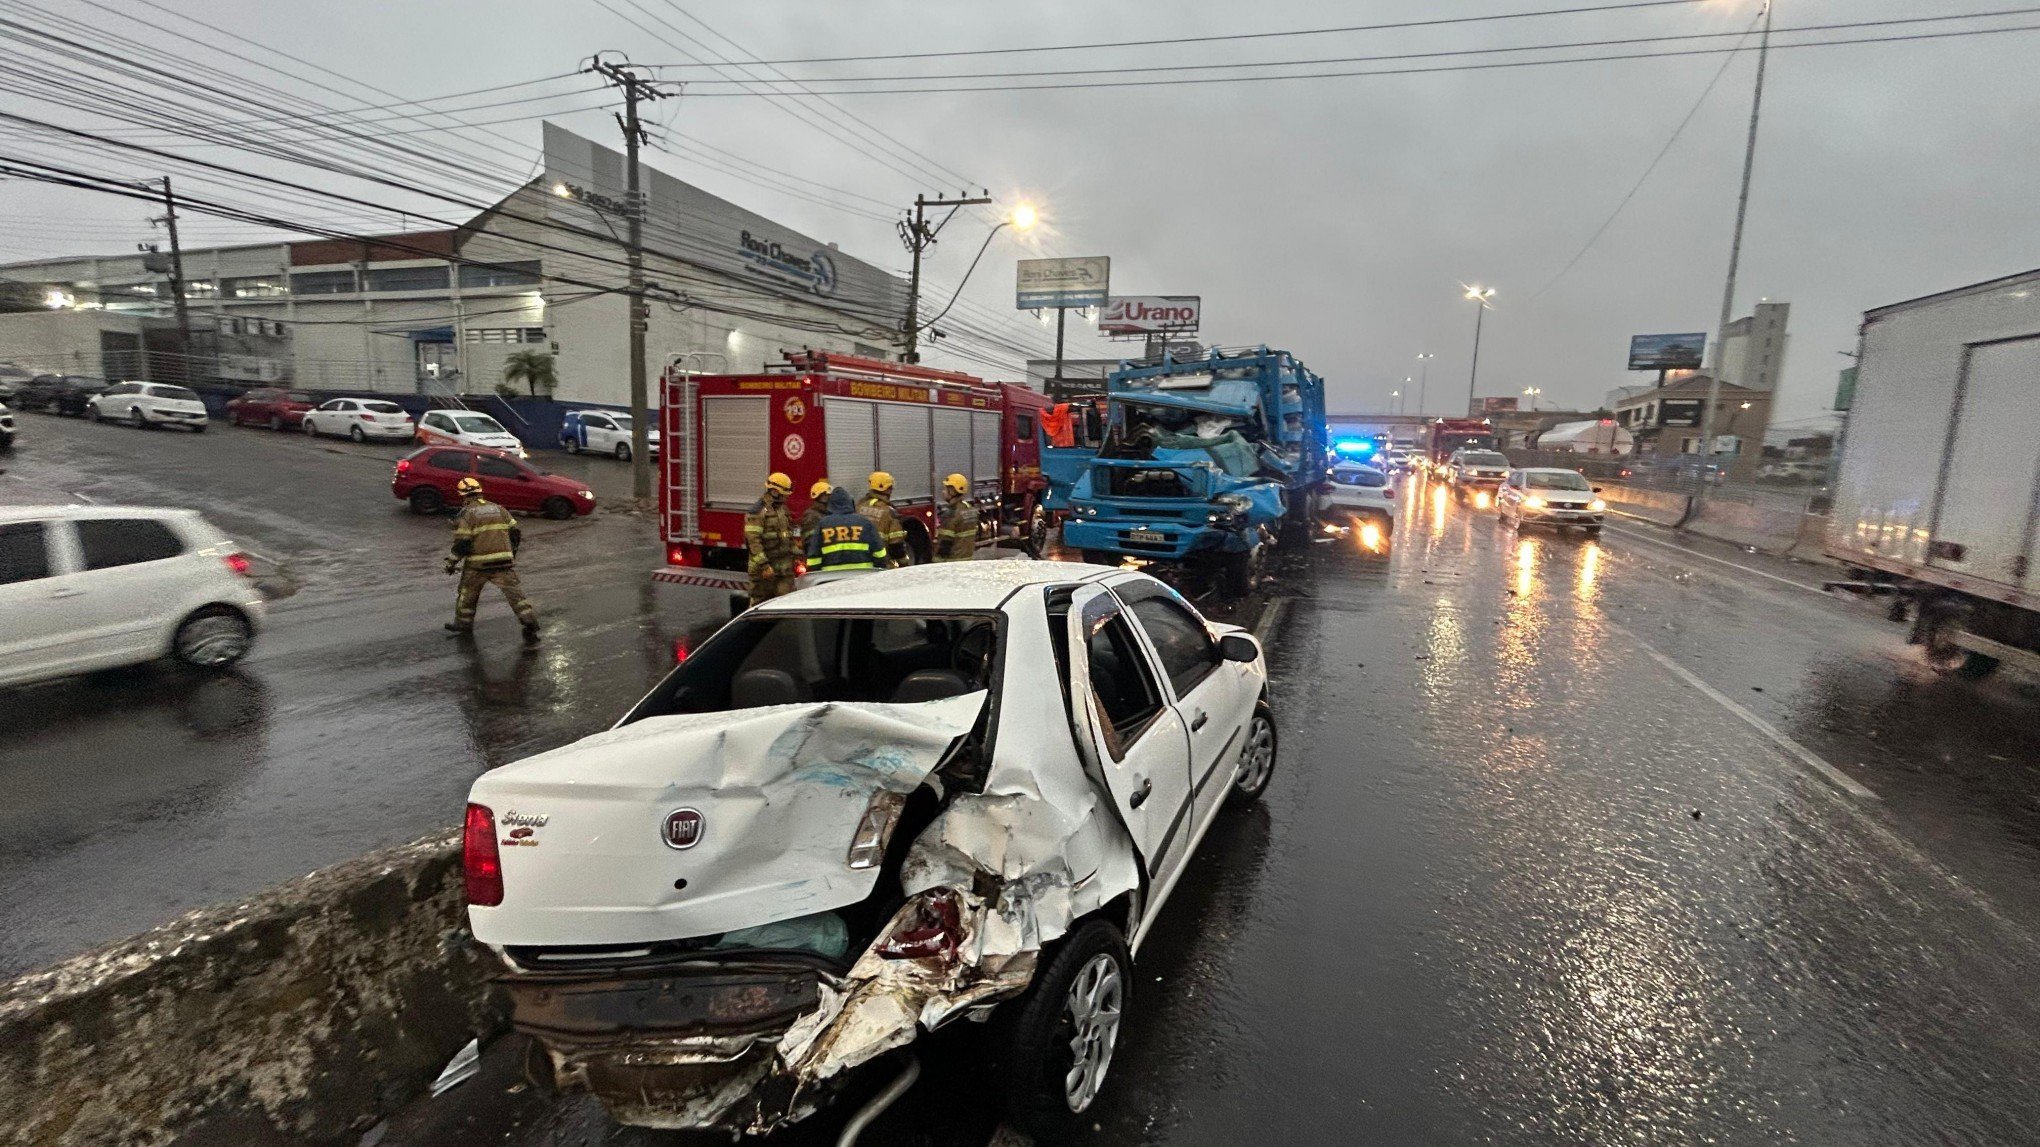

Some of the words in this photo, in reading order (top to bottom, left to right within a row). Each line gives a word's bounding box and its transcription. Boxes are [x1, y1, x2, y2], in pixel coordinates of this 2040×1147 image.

[1125, 302, 1194, 321] Urano
[850, 381, 897, 399] BOMBEIRO
[897, 386, 929, 402] MILITAR
[787, 404, 805, 416] 193
[821, 525, 863, 543] PRF
[501, 809, 549, 828] Siena
[671, 819, 697, 839] FIAT
